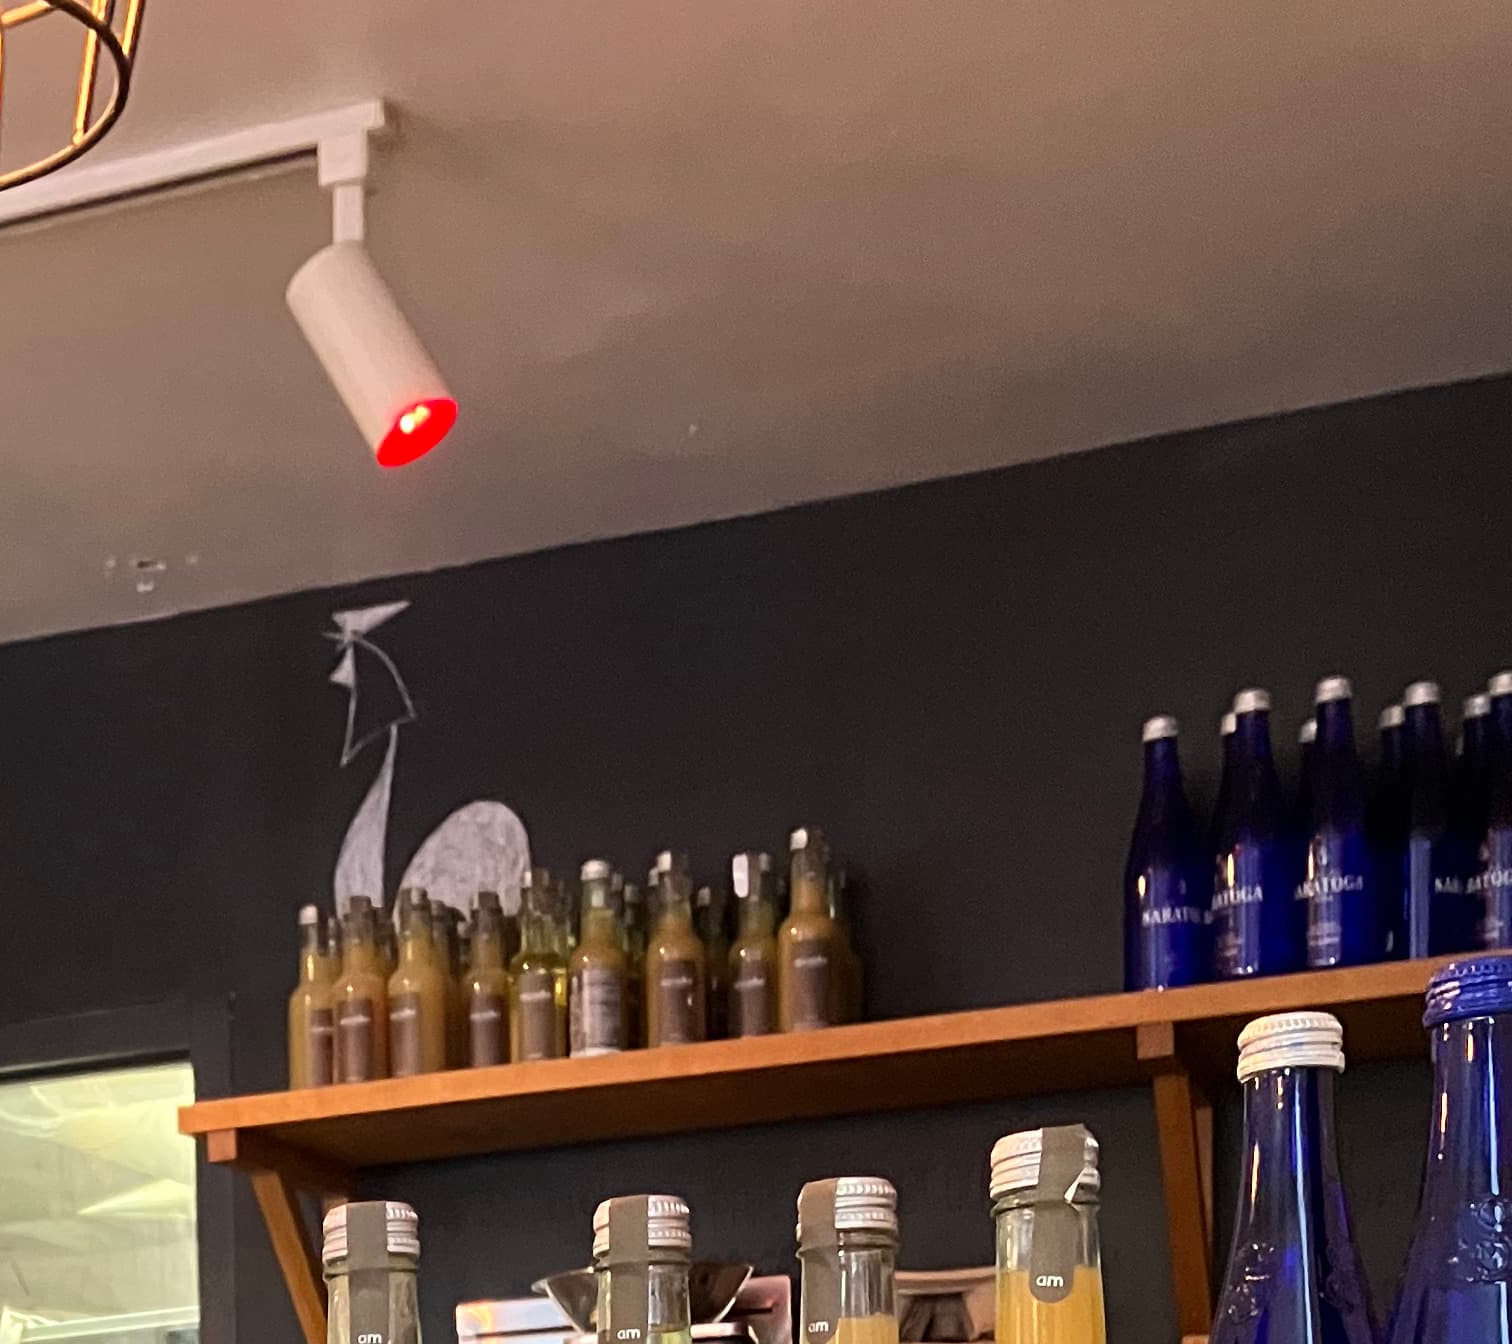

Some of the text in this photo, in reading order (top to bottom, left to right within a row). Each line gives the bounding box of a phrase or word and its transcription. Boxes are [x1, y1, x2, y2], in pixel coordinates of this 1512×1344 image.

[1036, 1273, 1064, 1288] am
[357, 1333, 383, 1344] am
[617, 1328, 641, 1341] am
